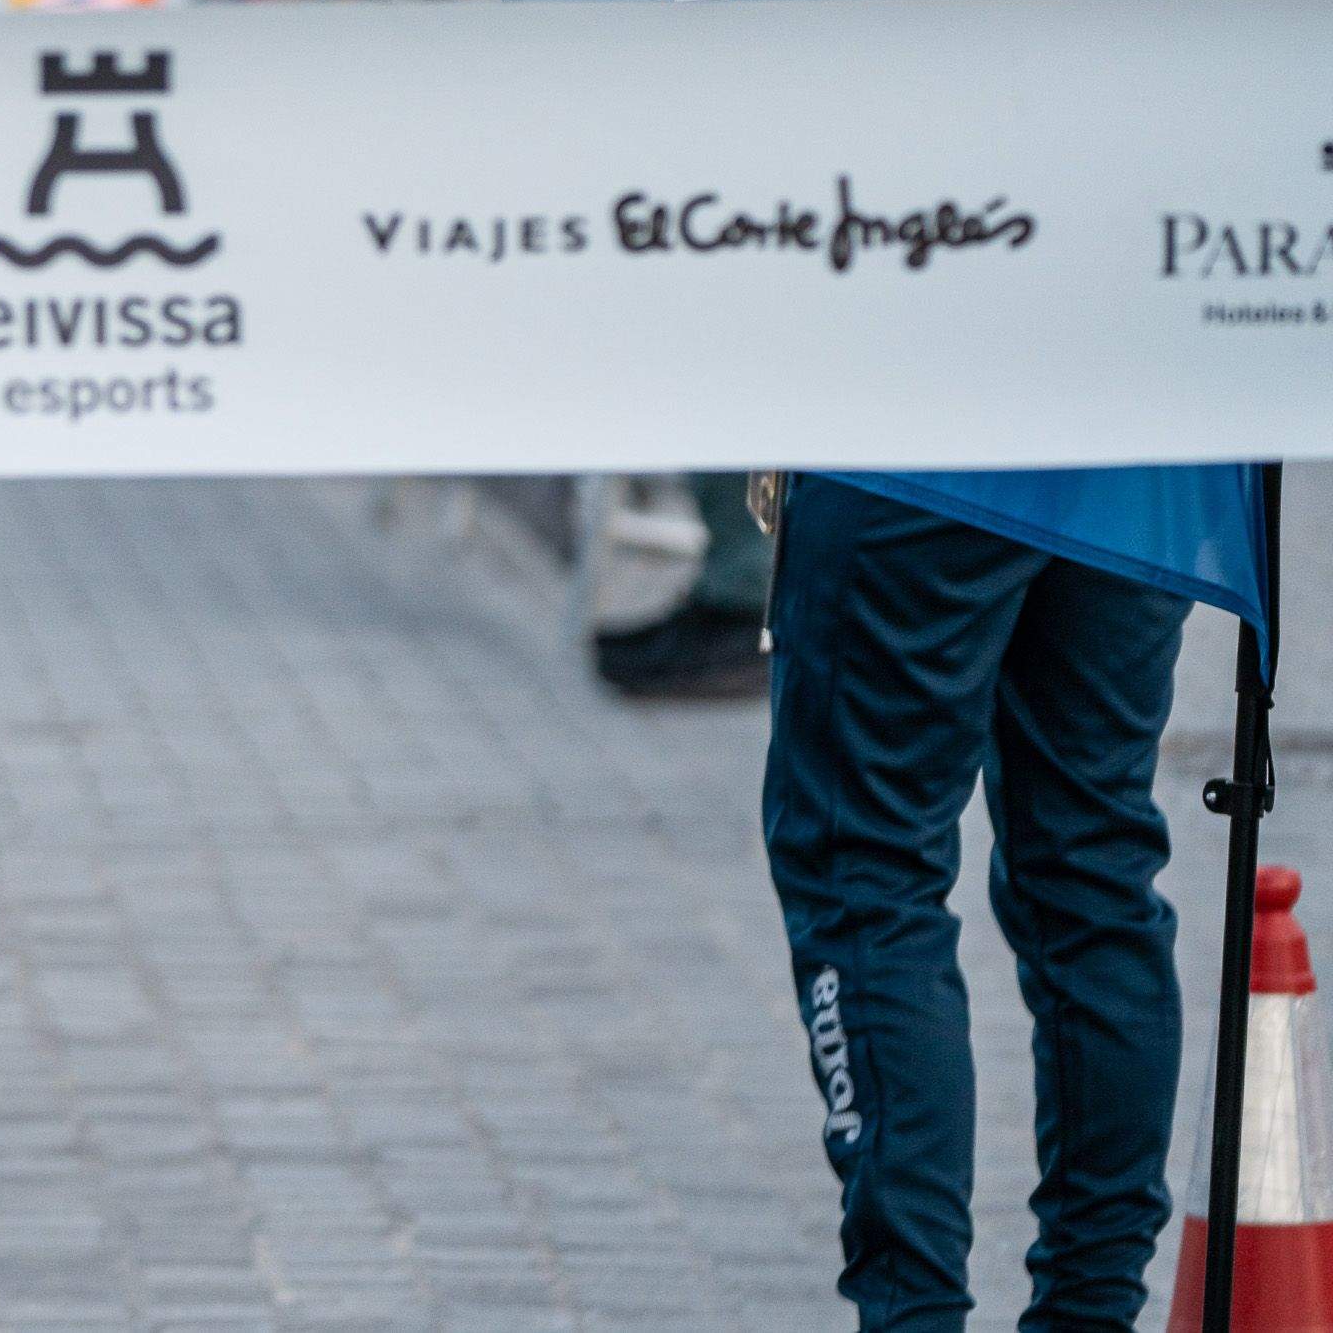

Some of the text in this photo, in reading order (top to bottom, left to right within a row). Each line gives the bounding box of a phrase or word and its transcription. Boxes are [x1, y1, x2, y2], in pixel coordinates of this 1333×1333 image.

[362, 174, 1038, 275] VIAJES El Corte Inglés
[1, 366, 215, 422] esports
